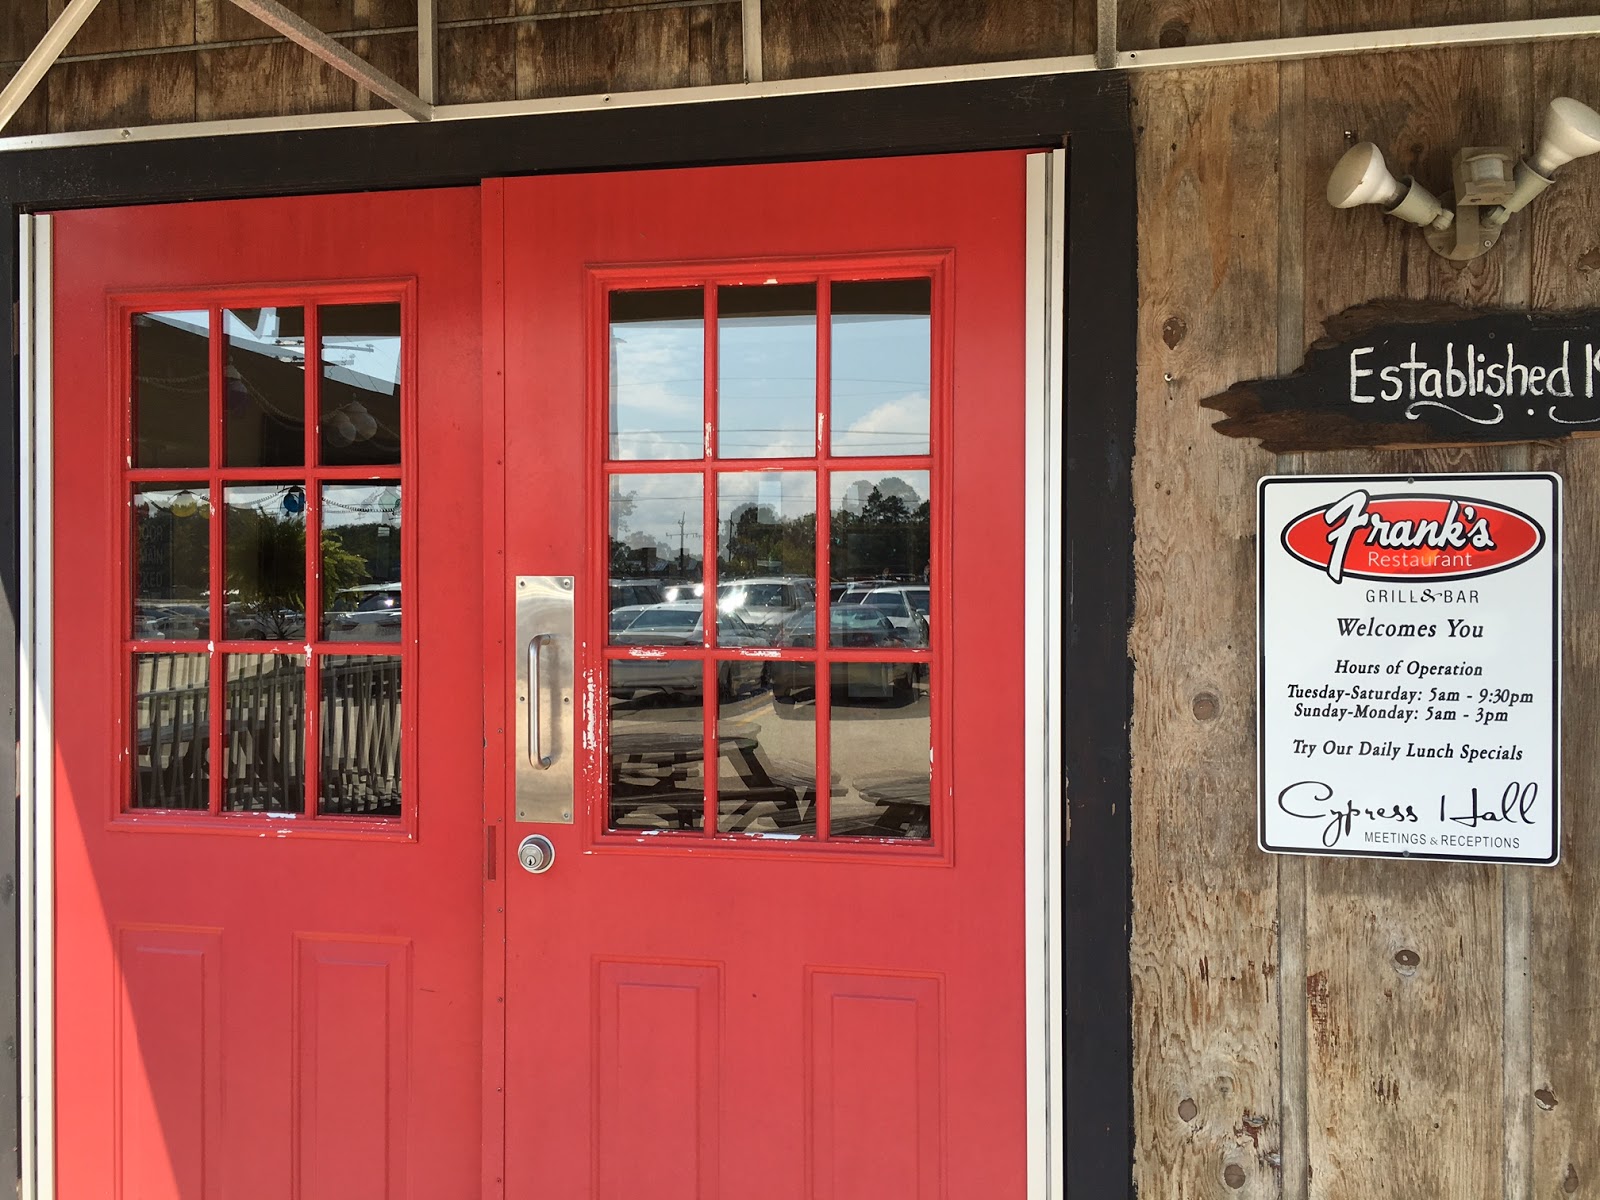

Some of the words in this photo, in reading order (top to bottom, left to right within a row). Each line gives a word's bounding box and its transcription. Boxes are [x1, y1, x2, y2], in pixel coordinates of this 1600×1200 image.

[1350, 340, 1574, 403] Established
[1325, 490, 1495, 583] Frank's
[1368, 551, 1472, 567] Restaurant
[1336, 617, 1437, 638] Welcomes
[1447, 618, 1484, 639] You
[1334, 659, 1381, 675] Hours
[1386, 659, 1404, 675] of
[1406, 660, 1484, 680] Operation
[1287, 684, 1423, 703] Tuesday-Saturday:
[1428, 688, 1461, 702] 5am
[1478, 688, 1534, 707] 9:30pm
[1293, 703, 1419, 722] Sunday-Monday:
[1424, 706, 1457, 721] 5am
[1474, 707, 1509, 726] 3pm
[1292, 739, 1318, 758] Try
[1322, 740, 1354, 756] Our
[1358, 742, 1402, 761] Daily
[1405, 743, 1455, 759] Lunch
[1459, 744, 1524, 764] Specials
[1277, 780, 1419, 848] Cypress
[1440, 781, 1539, 828] Hall
[1364, 831, 1427, 845] MEETINGS
[1440, 834, 1520, 849] RECEPTIONS
